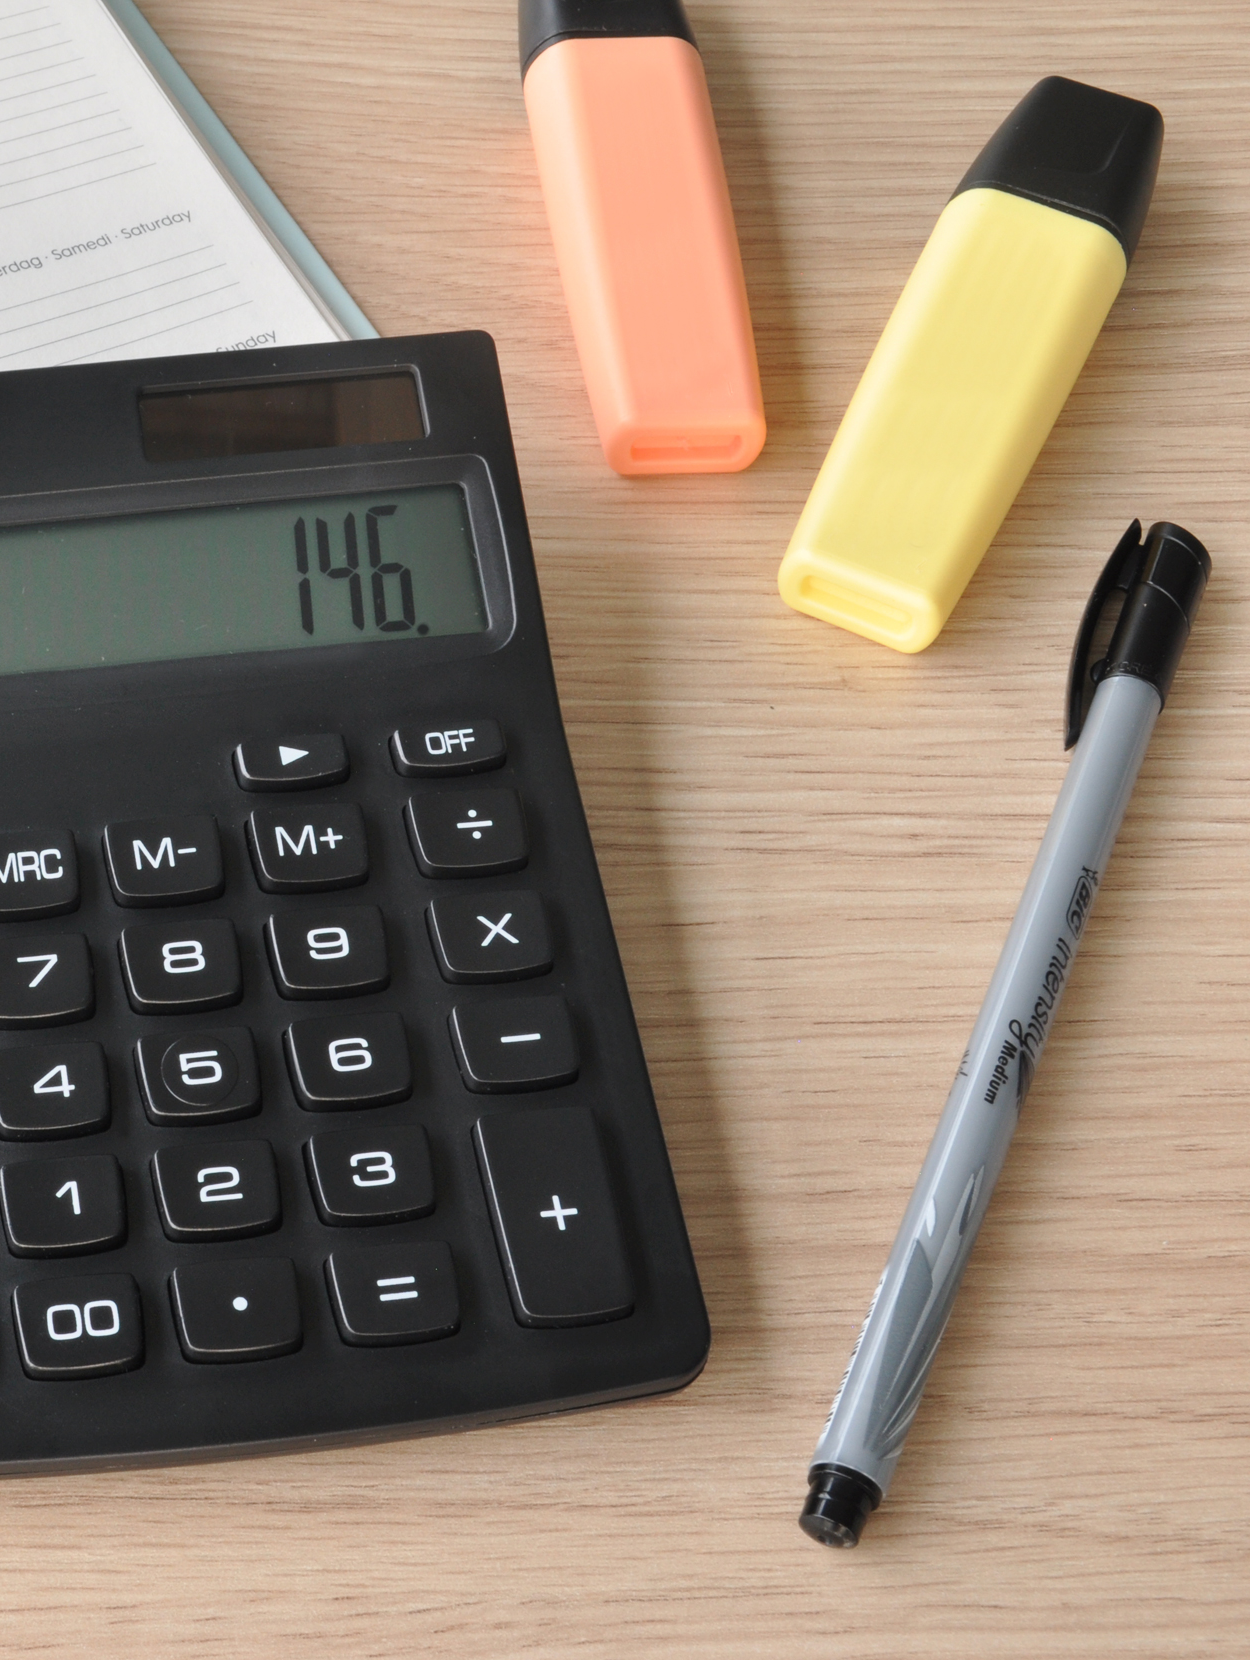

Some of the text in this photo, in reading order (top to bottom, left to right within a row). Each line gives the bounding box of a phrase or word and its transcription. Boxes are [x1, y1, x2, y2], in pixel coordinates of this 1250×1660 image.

[51, 233, 113, 261] Samedi
[121, 210, 192, 239] Saturday
[425, 729, 475, 755] OFF
[133, 837, 197, 870] M-
[275, 825, 343, 857] M+
[162, 940, 206, 974] 8
[307, 927, 350, 960] 9
[17, 954, 58, 988] 7
[179, 1050, 223, 1086] 5
[328, 1037, 373, 1072] 6
[984, 1039, 1018, 1104] Medium
[33, 1064, 75, 1098] 4
[197, 1166, 244, 1203] 2
[350, 1151, 396, 1187] 3
[55, 1180, 81, 1215] 1
